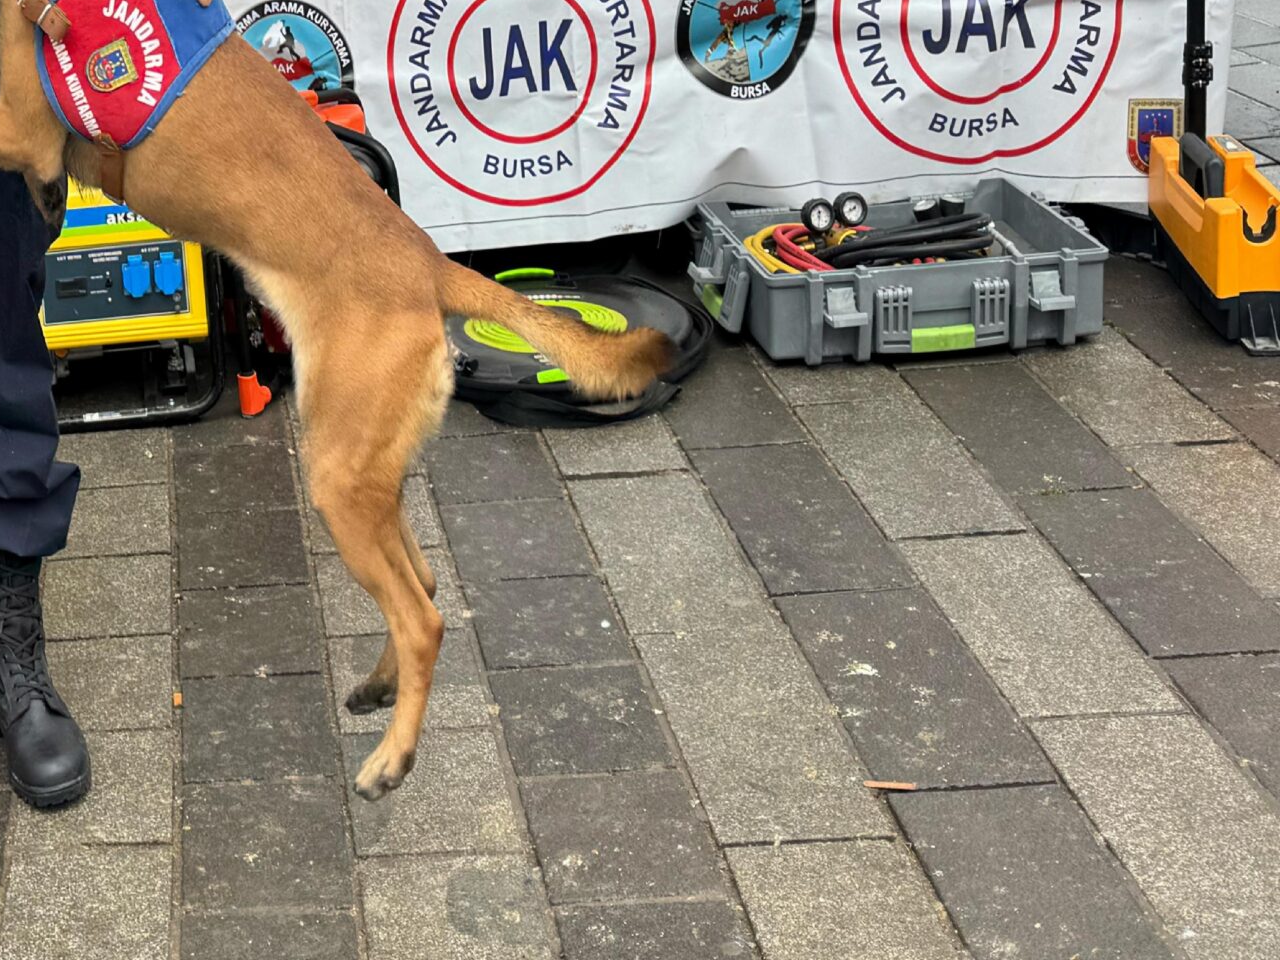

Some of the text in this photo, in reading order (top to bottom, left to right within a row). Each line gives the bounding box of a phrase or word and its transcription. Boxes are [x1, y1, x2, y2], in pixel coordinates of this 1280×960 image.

[733, 4, 759, 18] JAK
[263, 1, 305, 16] ARAMA
[306, 8, 351, 68] KURTARMA
[274, 63, 296, 74] AK
[468, 18, 578, 102] JAK
[64, 72, 102, 138] KURTARMA
[730, 81, 771, 99] BURSA
[928, 107, 1020, 138] BURSA
[482, 149, 573, 179] BURSA
